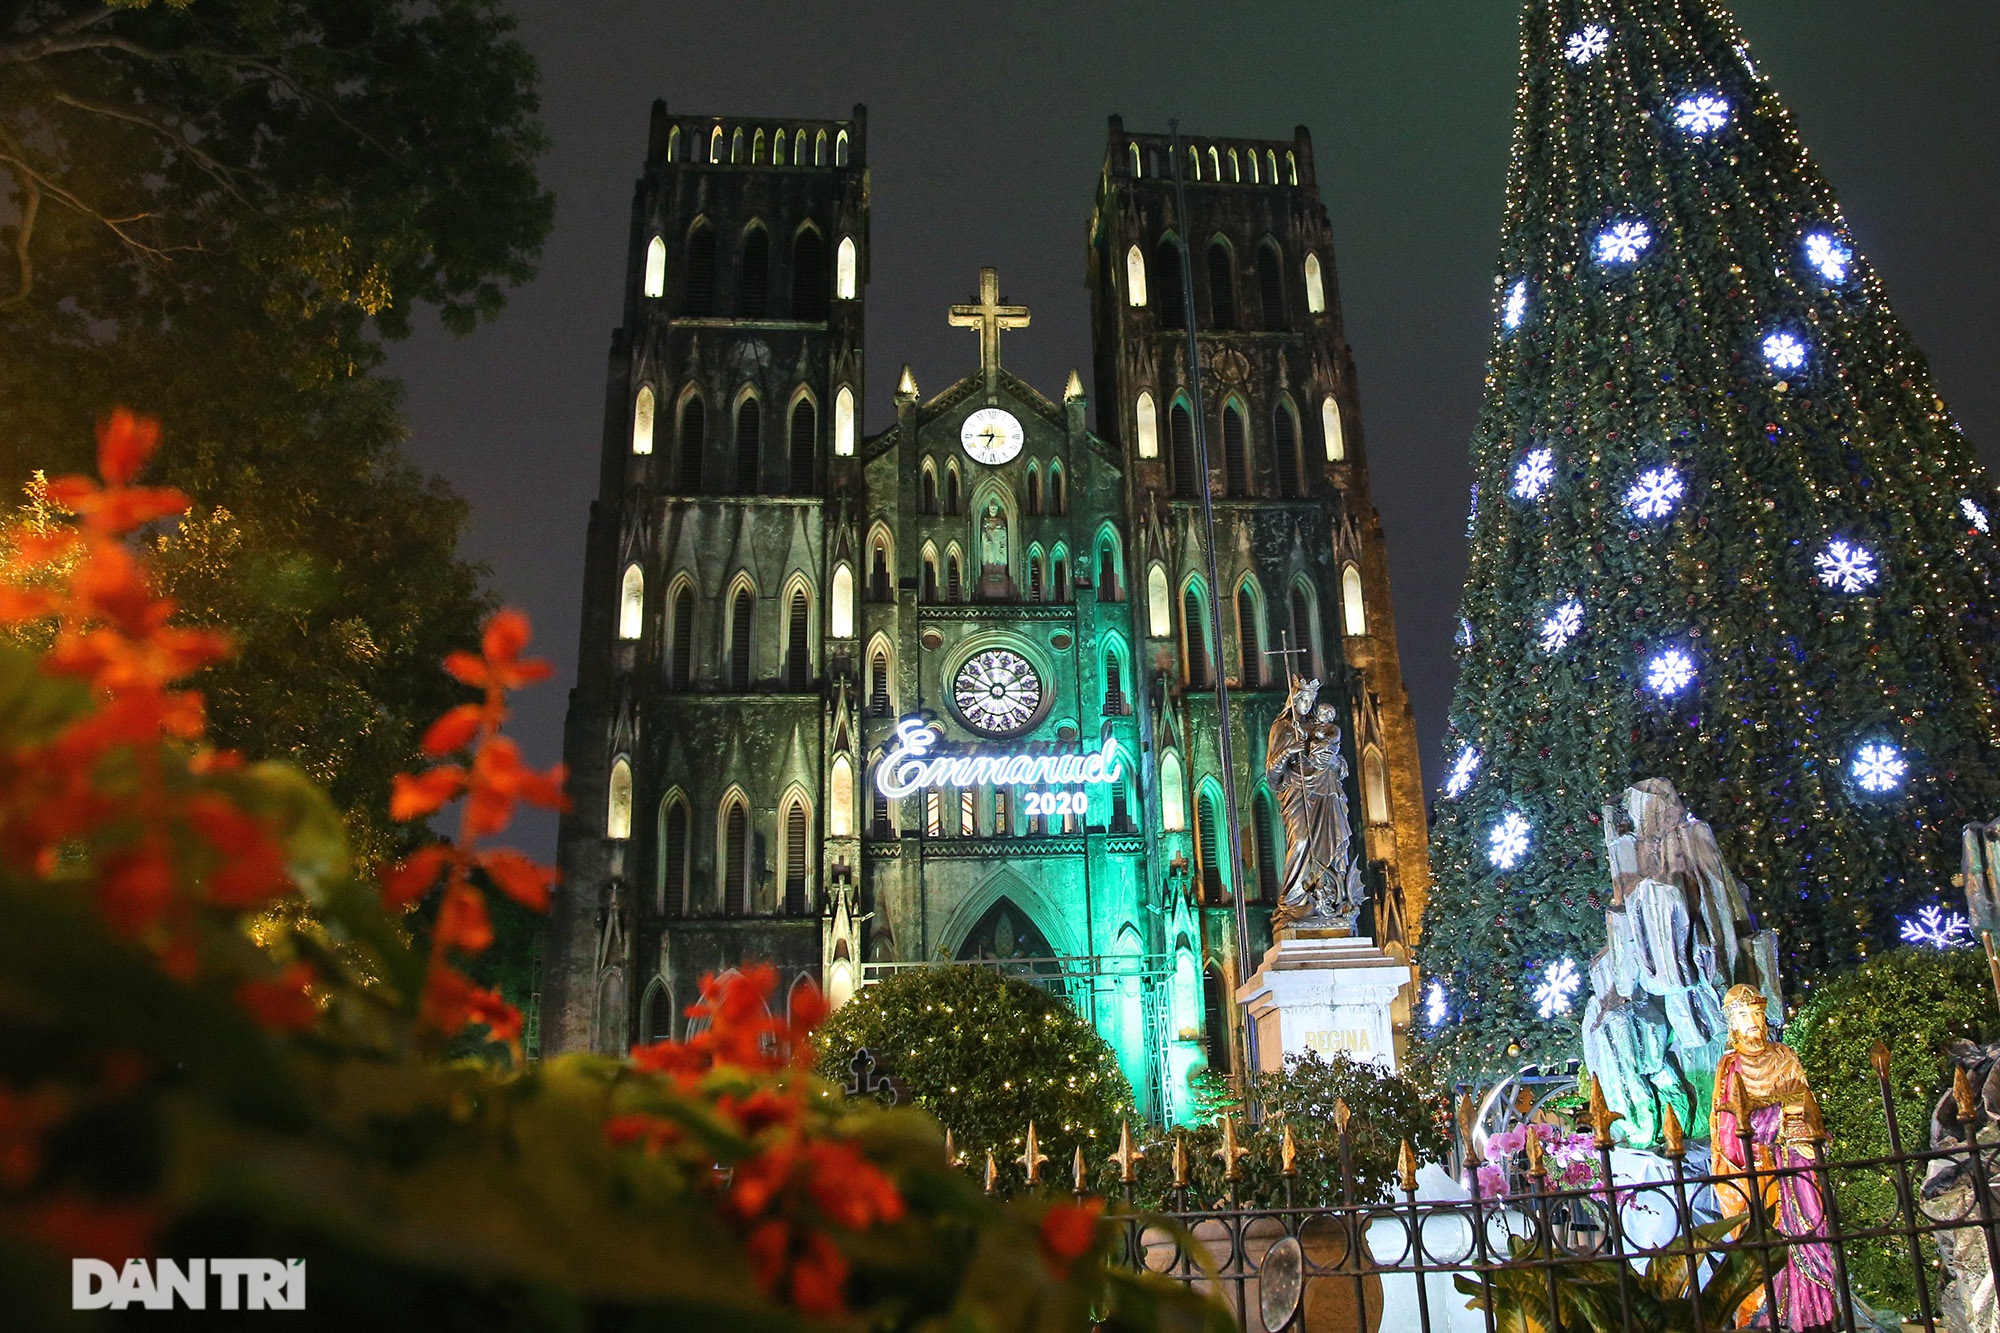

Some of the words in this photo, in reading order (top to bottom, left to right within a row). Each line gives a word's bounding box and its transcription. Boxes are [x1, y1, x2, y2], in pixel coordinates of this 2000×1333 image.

[877, 719, 1121, 798] Emmanuel
[1024, 791, 1088, 815] 2020
[1305, 1029, 1371, 1053] REGINA
